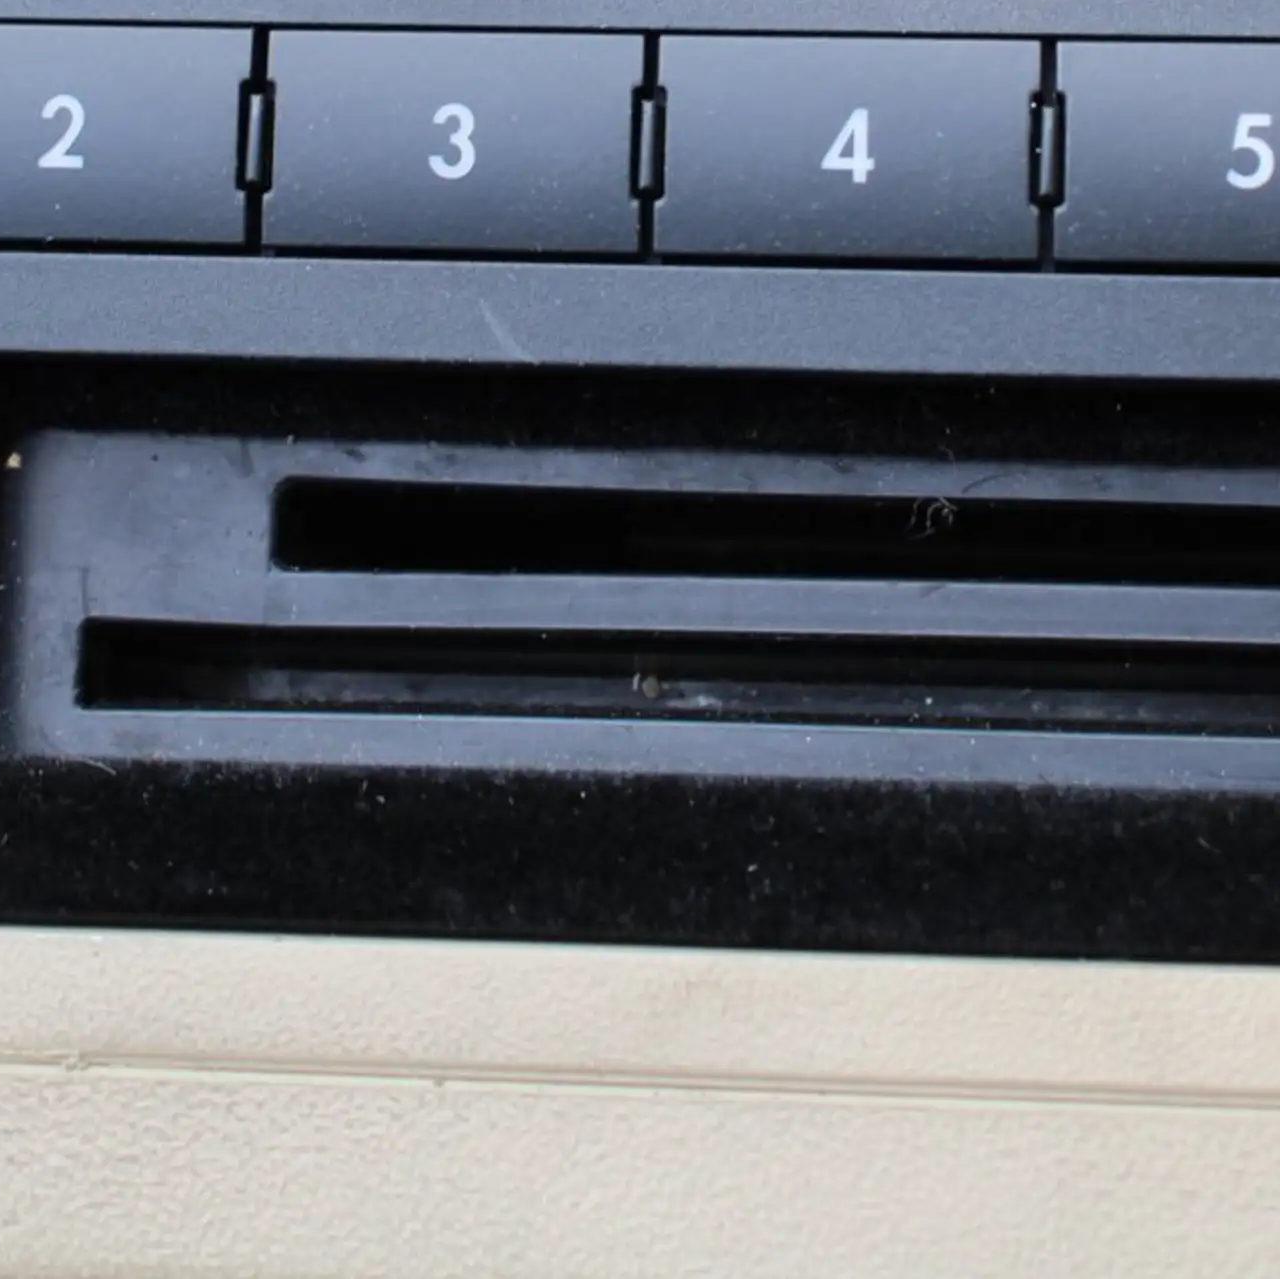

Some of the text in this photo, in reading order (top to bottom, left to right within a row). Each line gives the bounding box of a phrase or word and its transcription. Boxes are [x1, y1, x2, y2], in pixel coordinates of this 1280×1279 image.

[37, 94, 86, 170] 2
[427, 101, 477, 180] 3
[820, 107, 876, 184] 4
[1225, 111, 1276, 190] 5
